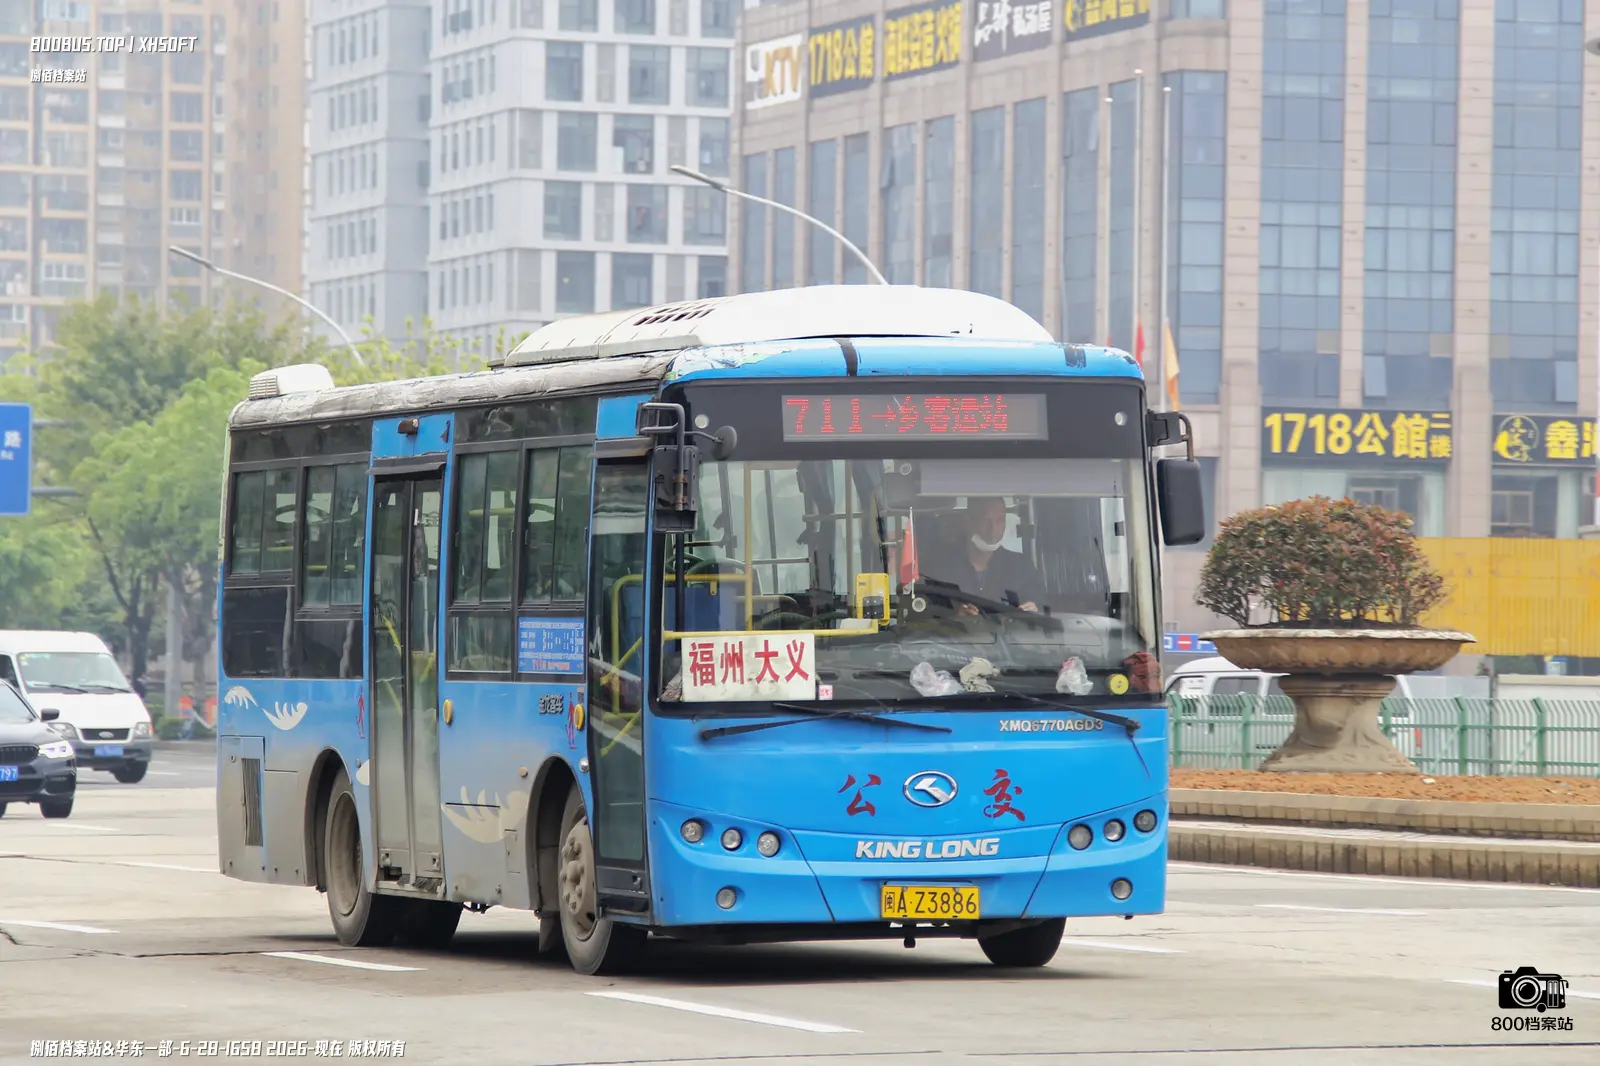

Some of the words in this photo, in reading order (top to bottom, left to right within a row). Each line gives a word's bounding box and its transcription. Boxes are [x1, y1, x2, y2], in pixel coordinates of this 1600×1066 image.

[763, 44, 801, 99] KTV
[1264, 411, 1430, 459] 1718公館
[688, 641, 745, 687] 福州
[755, 639, 810, 685] 大义
[999, 719, 1104, 732] XMQ6770AGD3
[837, 773, 882, 818] 公
[982, 768, 1027, 823] 交
[855, 839, 921, 859] KING
[925, 837, 1000, 858] LONG
